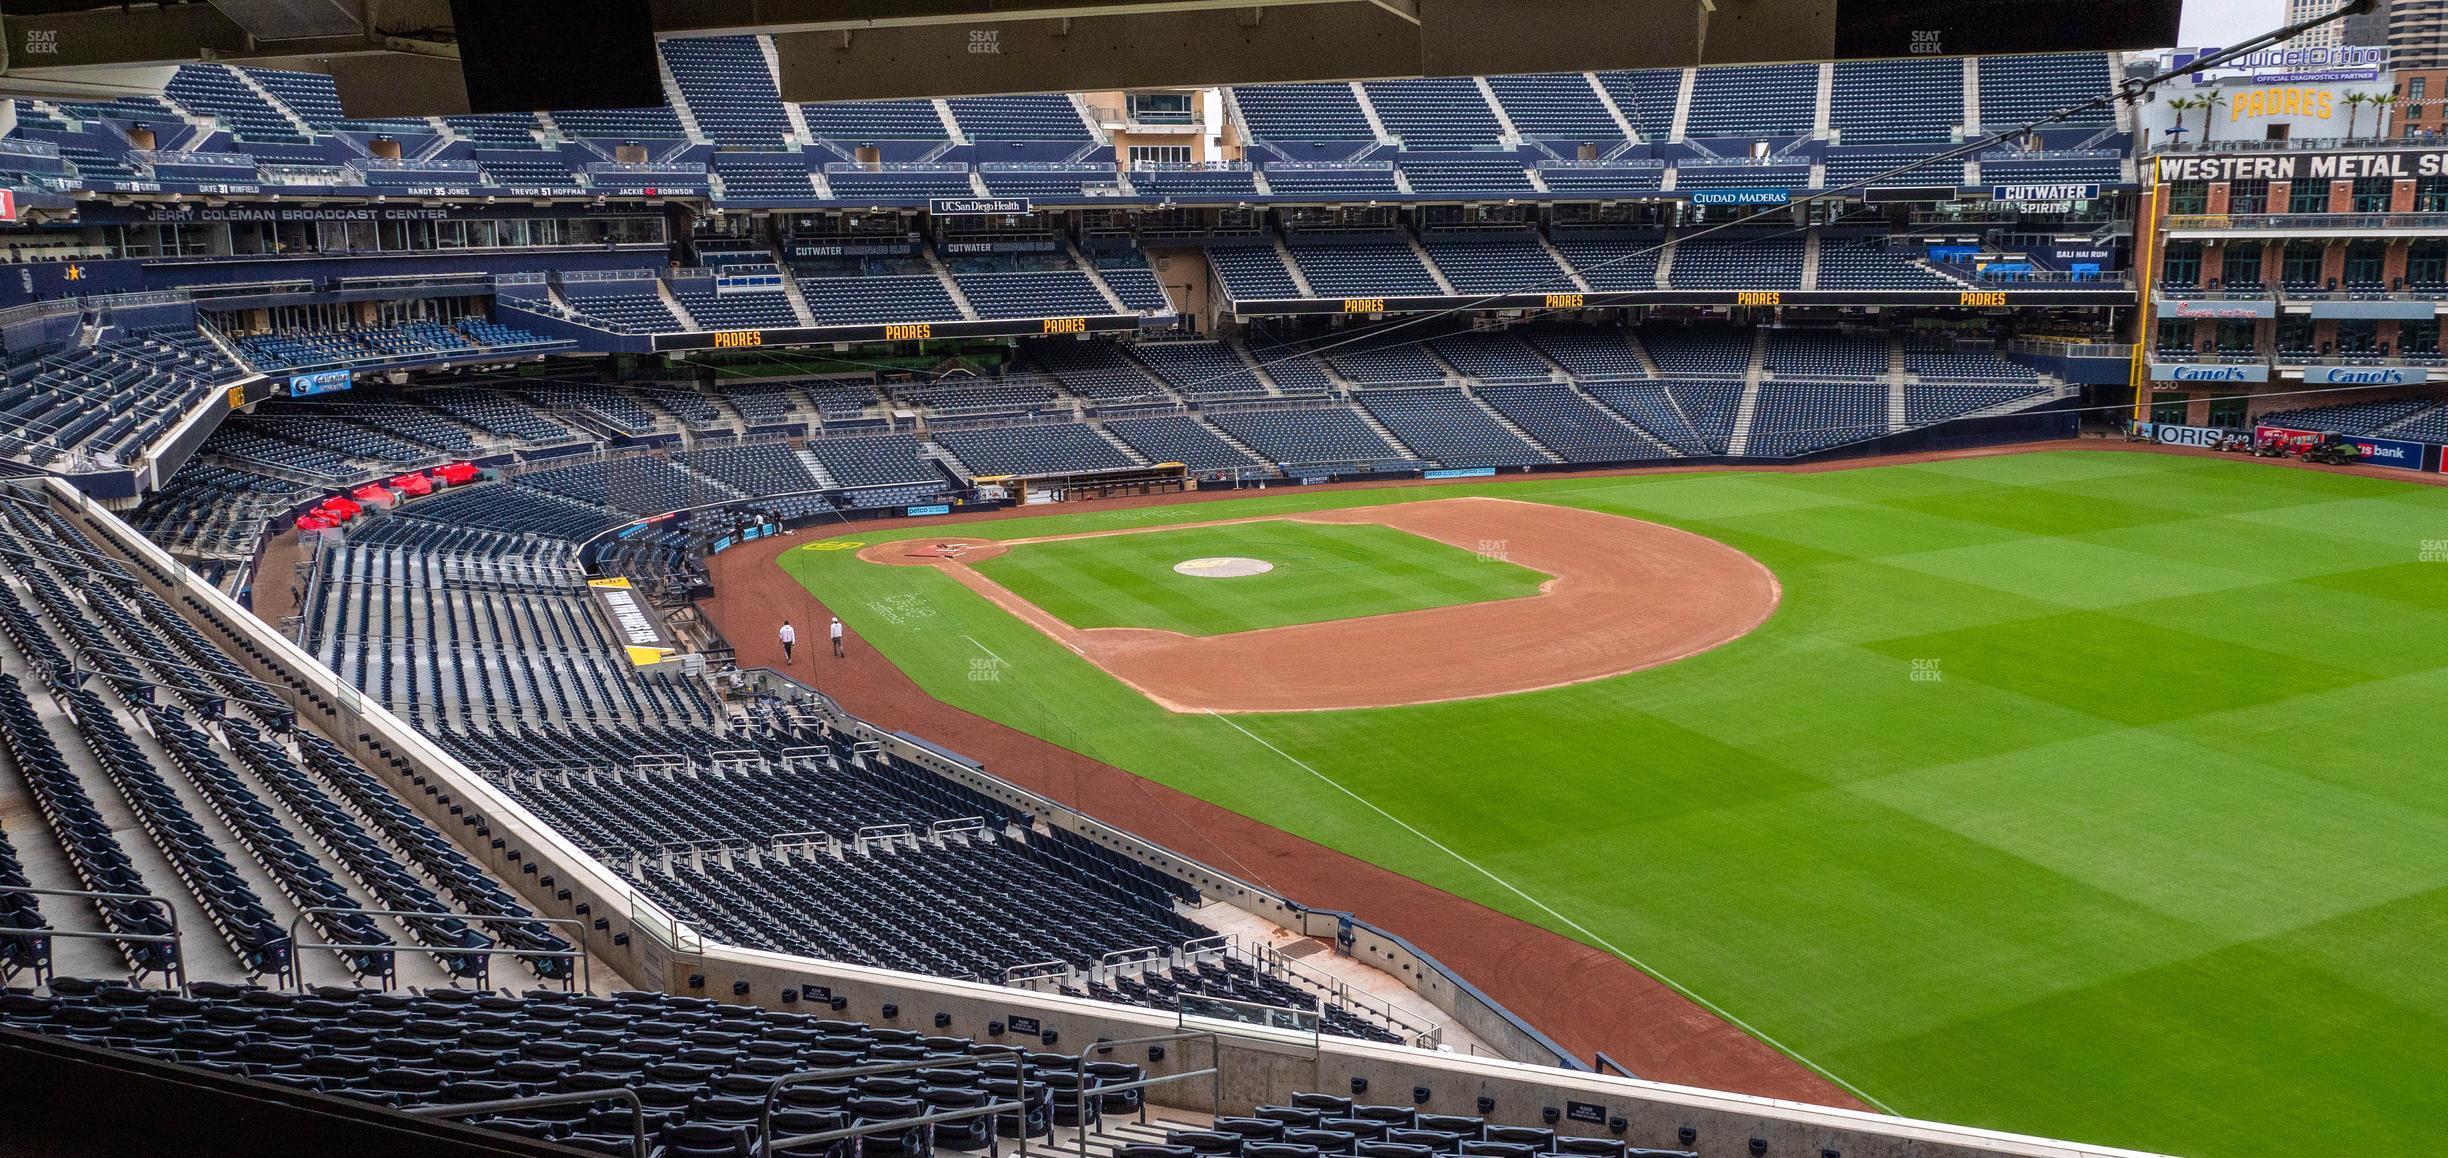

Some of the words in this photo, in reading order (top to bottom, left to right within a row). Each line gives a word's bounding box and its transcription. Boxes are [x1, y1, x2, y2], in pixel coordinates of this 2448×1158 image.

[2290, 73, 2338, 82] DIAGNOSTICS
[2339, 72, 2374, 80] PARTNER
[2231, 87, 2333, 122] PADRES
[2159, 157, 2296, 181] WESTERN
[2310, 154, 2409, 178] METAL
[218, 184, 229, 194] 31
[229, 186, 260, 194] WINFIELD
[407, 188, 433, 196] RANDY
[433, 187, 446, 196] 35
[446, 188, 470, 196] JONES
[510, 188, 540, 196] TREVOR
[541, 187, 552, 197] 51
[552, 188, 587, 196] HOFFMAN
[644, 188, 657, 196] 42
[2005, 186, 2087, 199] CUTWATER
[1693, 193, 1736, 204] CIUDAD
[1739, 192, 1787, 203] MADERAS
[941, 201, 955, 211] UC
[954, 201, 971, 211] San
[970, 201, 994, 213] Diego
[993, 201, 1020, 211] Health
[2020, 203, 2069, 213] SPIRITS
[147, 209, 195, 221] JERRY
[201, 209, 276, 221] COLEMAN
[282, 209, 378, 221] BROADCAST
[385, 209, 448, 220] CENTER
[795, 246, 842, 257] CUTWATER
[948, 243, 992, 253] CUTWATER
[2056, 250, 2074, 258] BALI
[2075, 250, 2089, 258] HAI
[2091, 250, 2108, 258] RUM
[1545, 294, 1582, 307] PADRES
[1738, 292, 1780, 305] PADRES
[1961, 292, 2006, 306] PADRES
[1344, 299, 1384, 313] PADRES
[885, 325, 931, 340] PADRES
[1043, 318, 1086, 334] PADRES
[715, 331, 762, 348] PADRES
[2173, 366, 2247, 381] Canel's
[2327, 368, 2402, 383] Canel's
[2161, 426, 2220, 447] ORIS
[2373, 445, 2405, 459] bank
